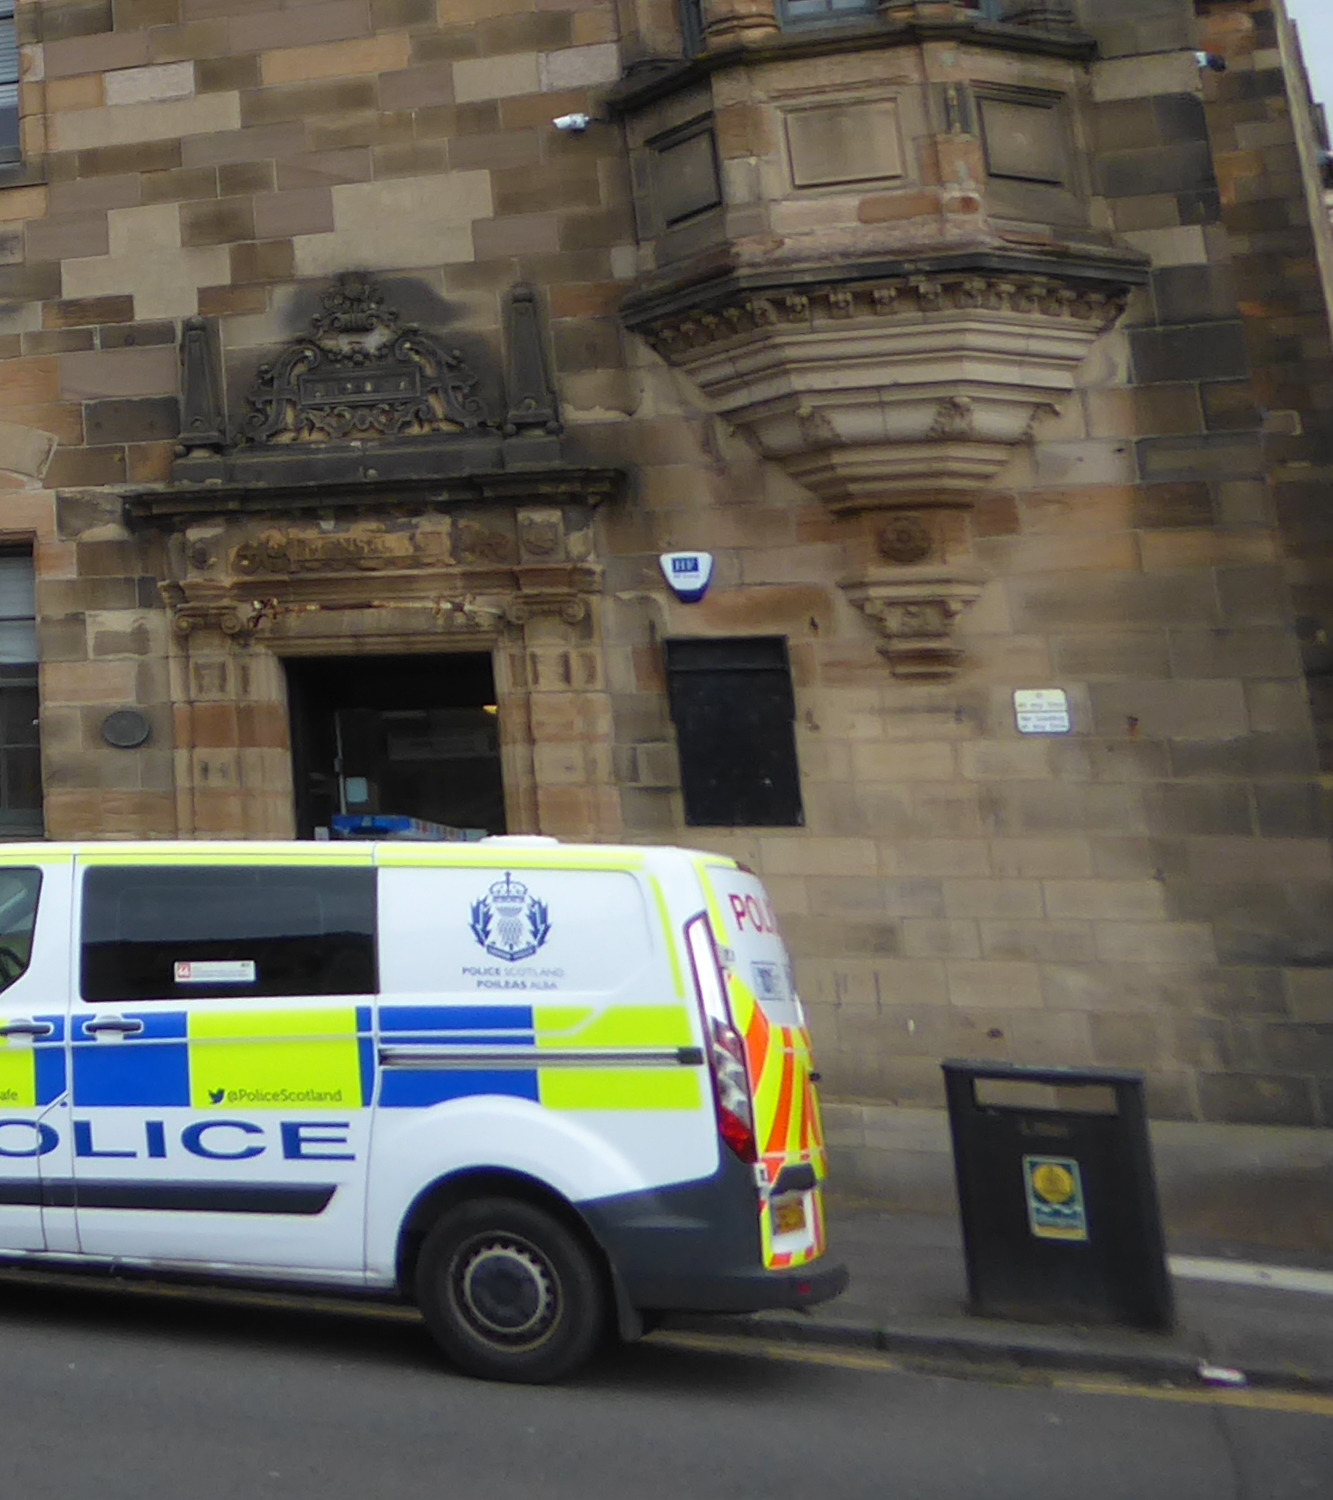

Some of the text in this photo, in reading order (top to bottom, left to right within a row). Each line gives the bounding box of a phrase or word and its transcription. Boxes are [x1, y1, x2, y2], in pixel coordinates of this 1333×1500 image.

[462, 966, 565, 978] POLICE SCOTLAND
[530, 980, 558, 990] ALBA
[226, 1088, 343, 1103] @PoliceScotland
